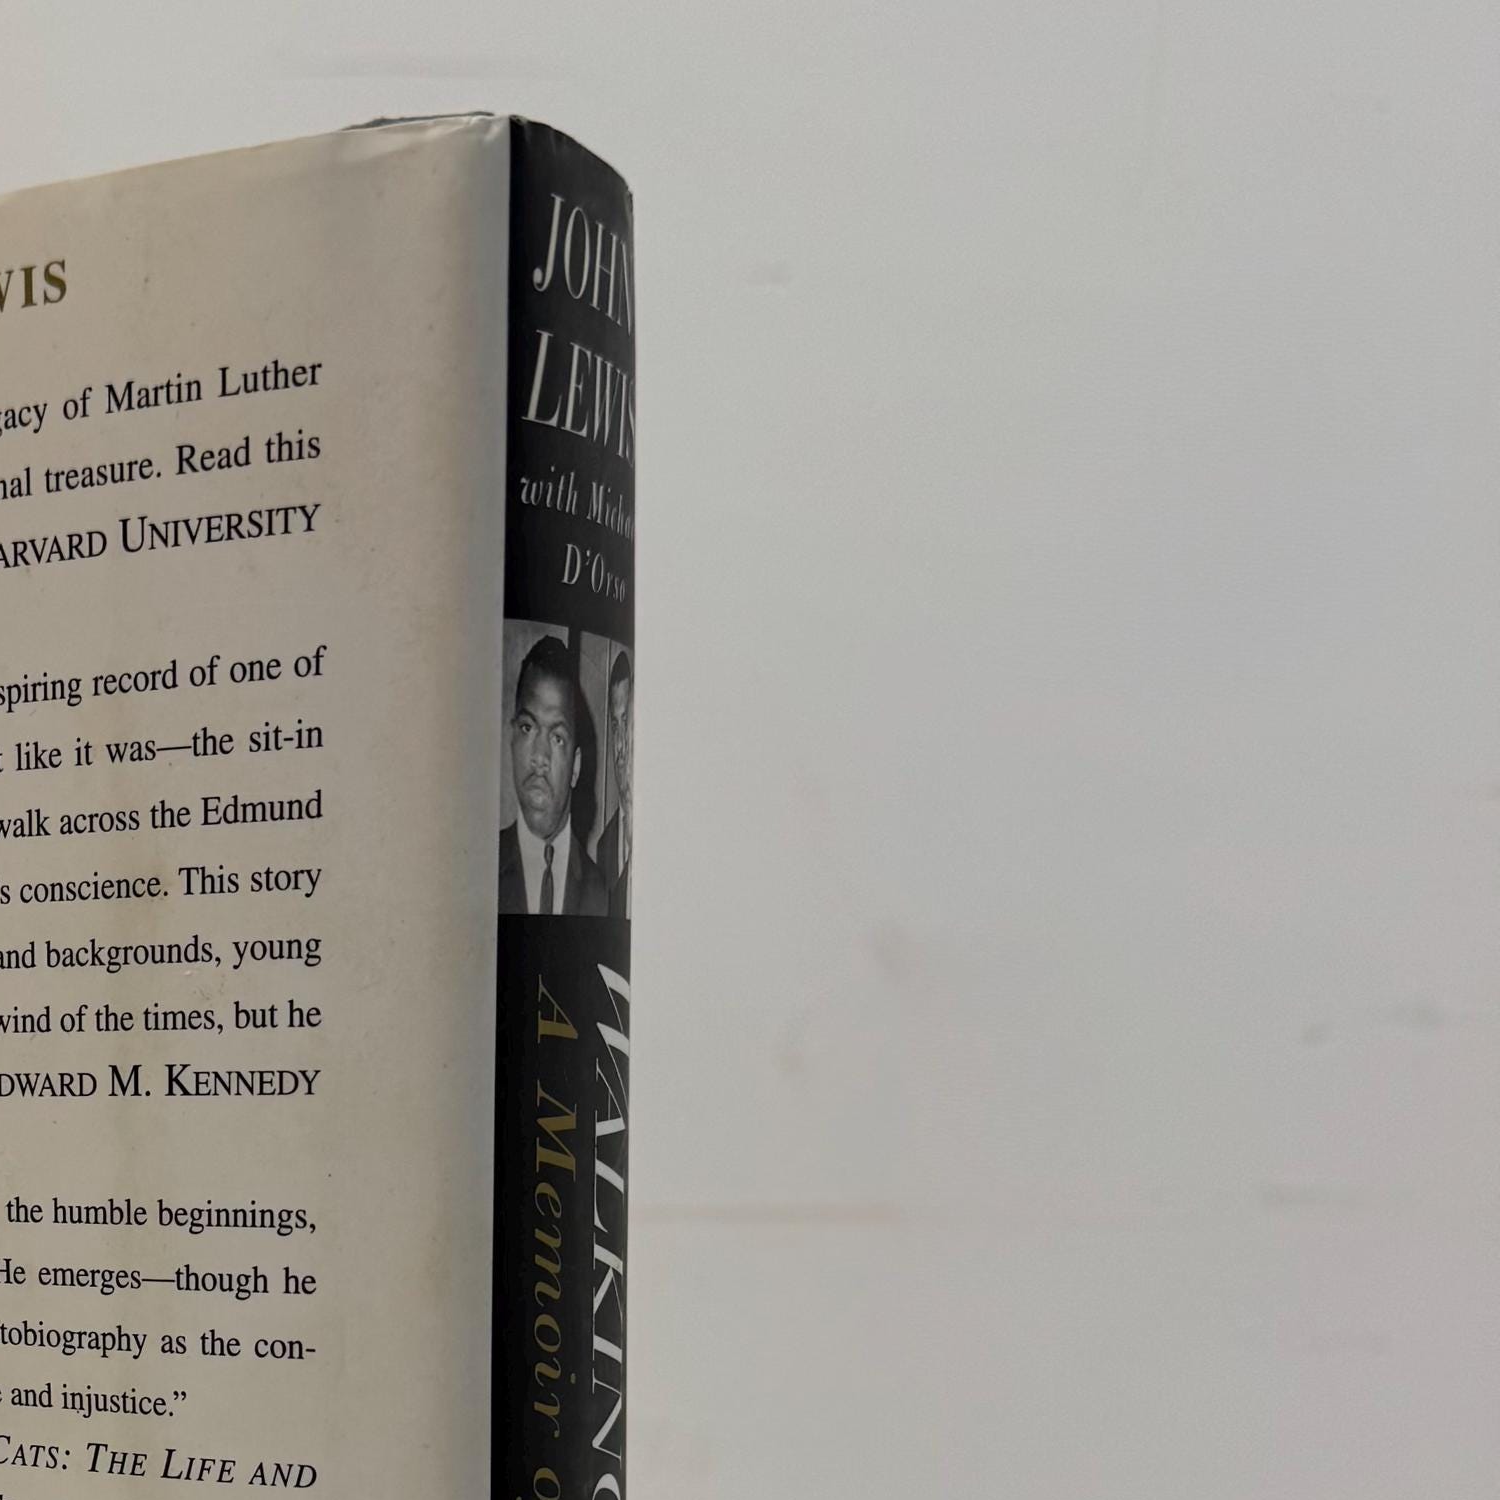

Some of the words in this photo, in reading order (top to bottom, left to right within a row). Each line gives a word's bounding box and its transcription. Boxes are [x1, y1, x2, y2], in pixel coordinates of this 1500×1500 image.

[533, 193, 632, 337] JOHN
[63, 386, 92, 420] of
[104, 372, 203, 414] Martin
[218, 358, 322, 398] Luther
[521, 329, 635, 468] LEWIS
[44, 458, 161, 493] treasure.
[175, 435, 252, 475] Read
[265, 429, 321, 464] this
[520, 465, 577, 515] with
[118, 503, 321, 553] UNIVERSITY
[92, 659, 179, 696] record
[189, 655, 220, 687] of
[230, 659, 282, 683] one
[294, 645, 327, 678] of
[15, 741, 62, 771] like
[74, 736, 94, 766] it
[249, 718, 324, 752] sit-in
[60, 809, 140, 835] across
[149, 799, 191, 829] the
[200, 789, 323, 826] Edmund
[20, 871, 168, 904] conscience.
[178, 864, 239, 895] This
[250, 866, 322, 898] story
[44, 934, 221, 975] backgrounds,
[231, 938, 322, 970] young
[60, 1004, 89, 1035] of
[94, 1004, 135, 1032] the
[141, 1002, 223, 1035] times,
[233, 1000, 279, 1029] but
[287, 998, 322, 1028] he
[538, 973, 579, 1044] A
[108, 1064, 151, 1096] M.
[164, 1064, 321, 1096] KENNEDY
[4, 1196, 44, 1224] the
[52, 1197, 148, 1226] humble
[157, 1199, 316, 1237] beginnings,
[282, 1266, 317, 1295] he
[533, 1079, 577, 1438] Memoir
[160, 1335, 187, 1354] as
[200, 1329, 241, 1357] the
[254, 1339, 316, 1360] con-
[10, 1382, 54, 1408] and
[86, 1442, 148, 1477] THE
[160, 1448, 236, 1484] LIFE
[248, 1462, 317, 1488] AND
